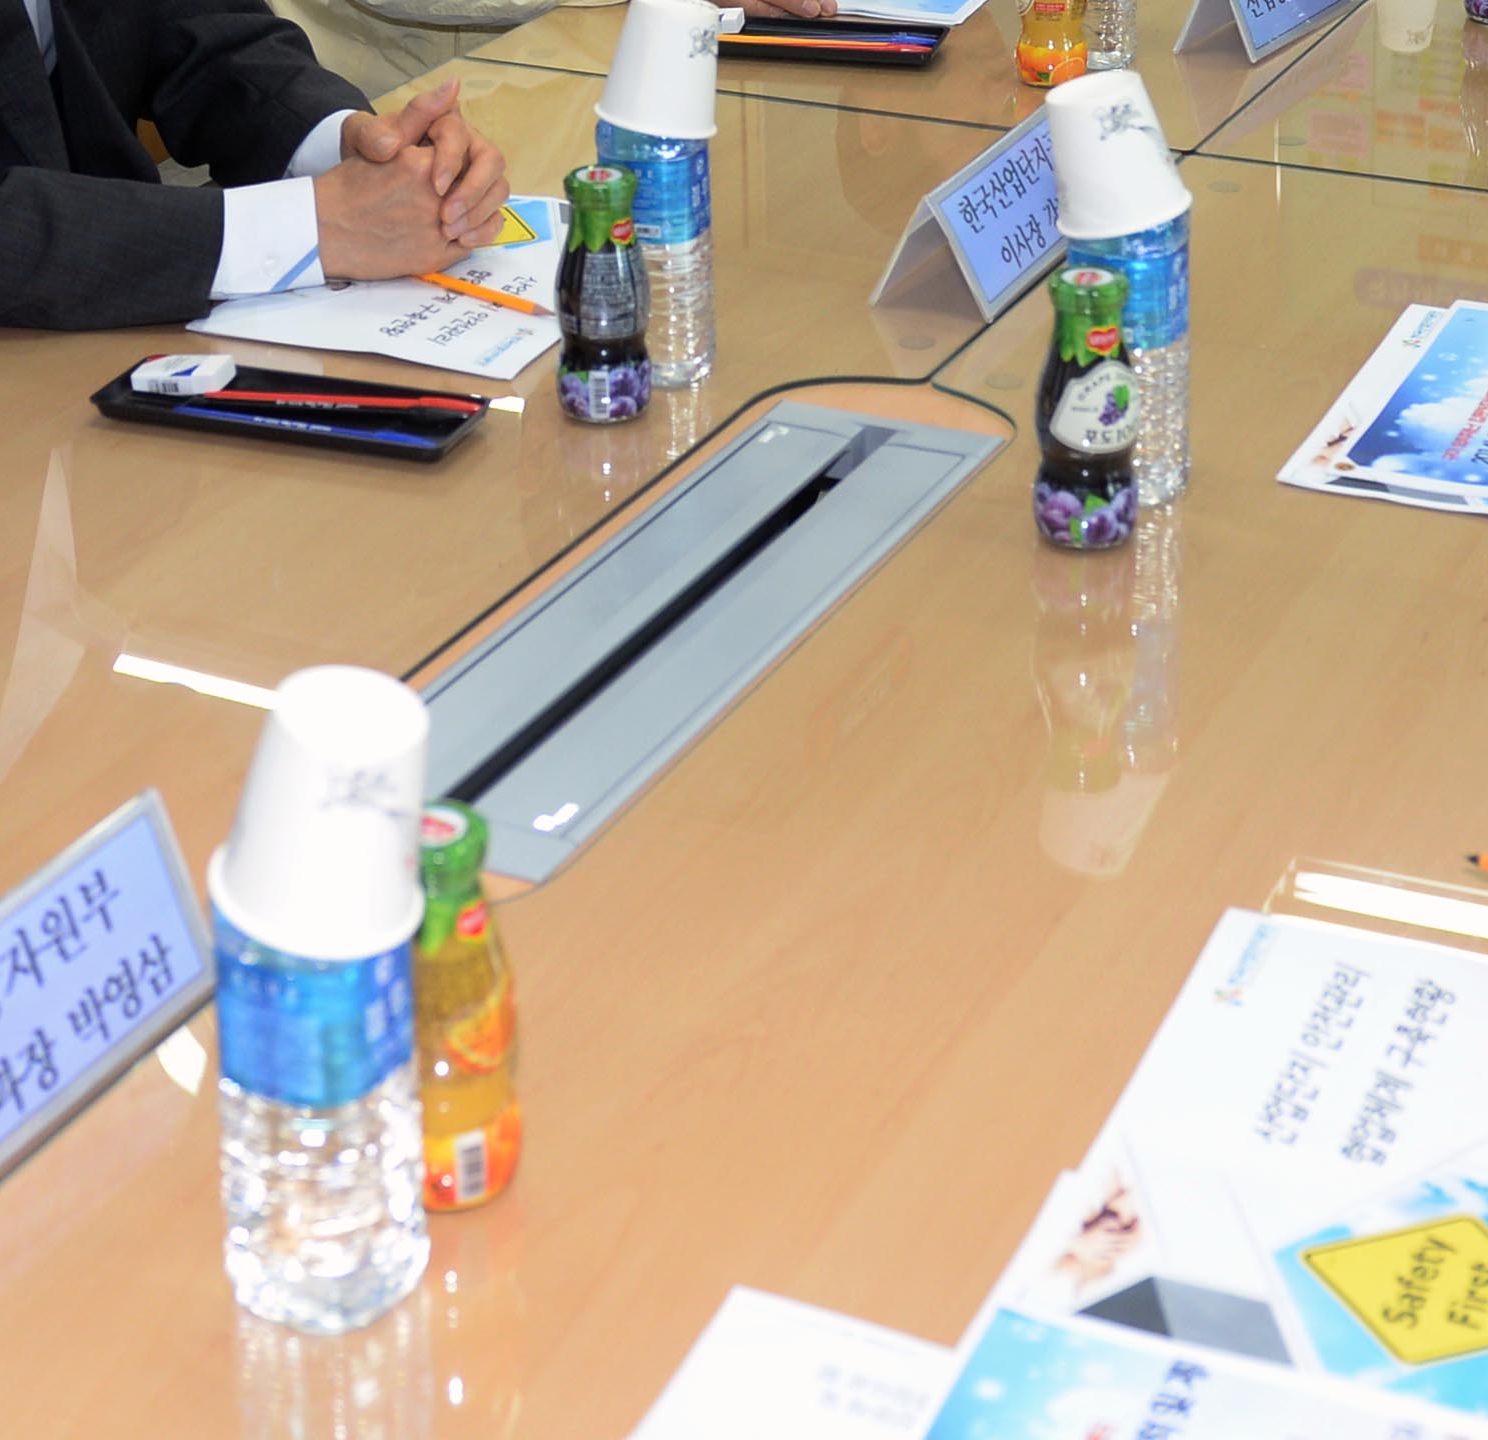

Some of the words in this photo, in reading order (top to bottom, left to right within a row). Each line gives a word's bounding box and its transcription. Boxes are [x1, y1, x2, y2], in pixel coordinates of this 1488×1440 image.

[957, 129, 1055, 235] 한국산업단지
[1000, 213, 1047, 269] 이사장
[425, 310, 490, 346] 안전관리
[66, 933, 175, 1041] 박영삼
[1300, 960, 1374, 1052] 안전관리
[1382, 1234, 1459, 1331] Safety
